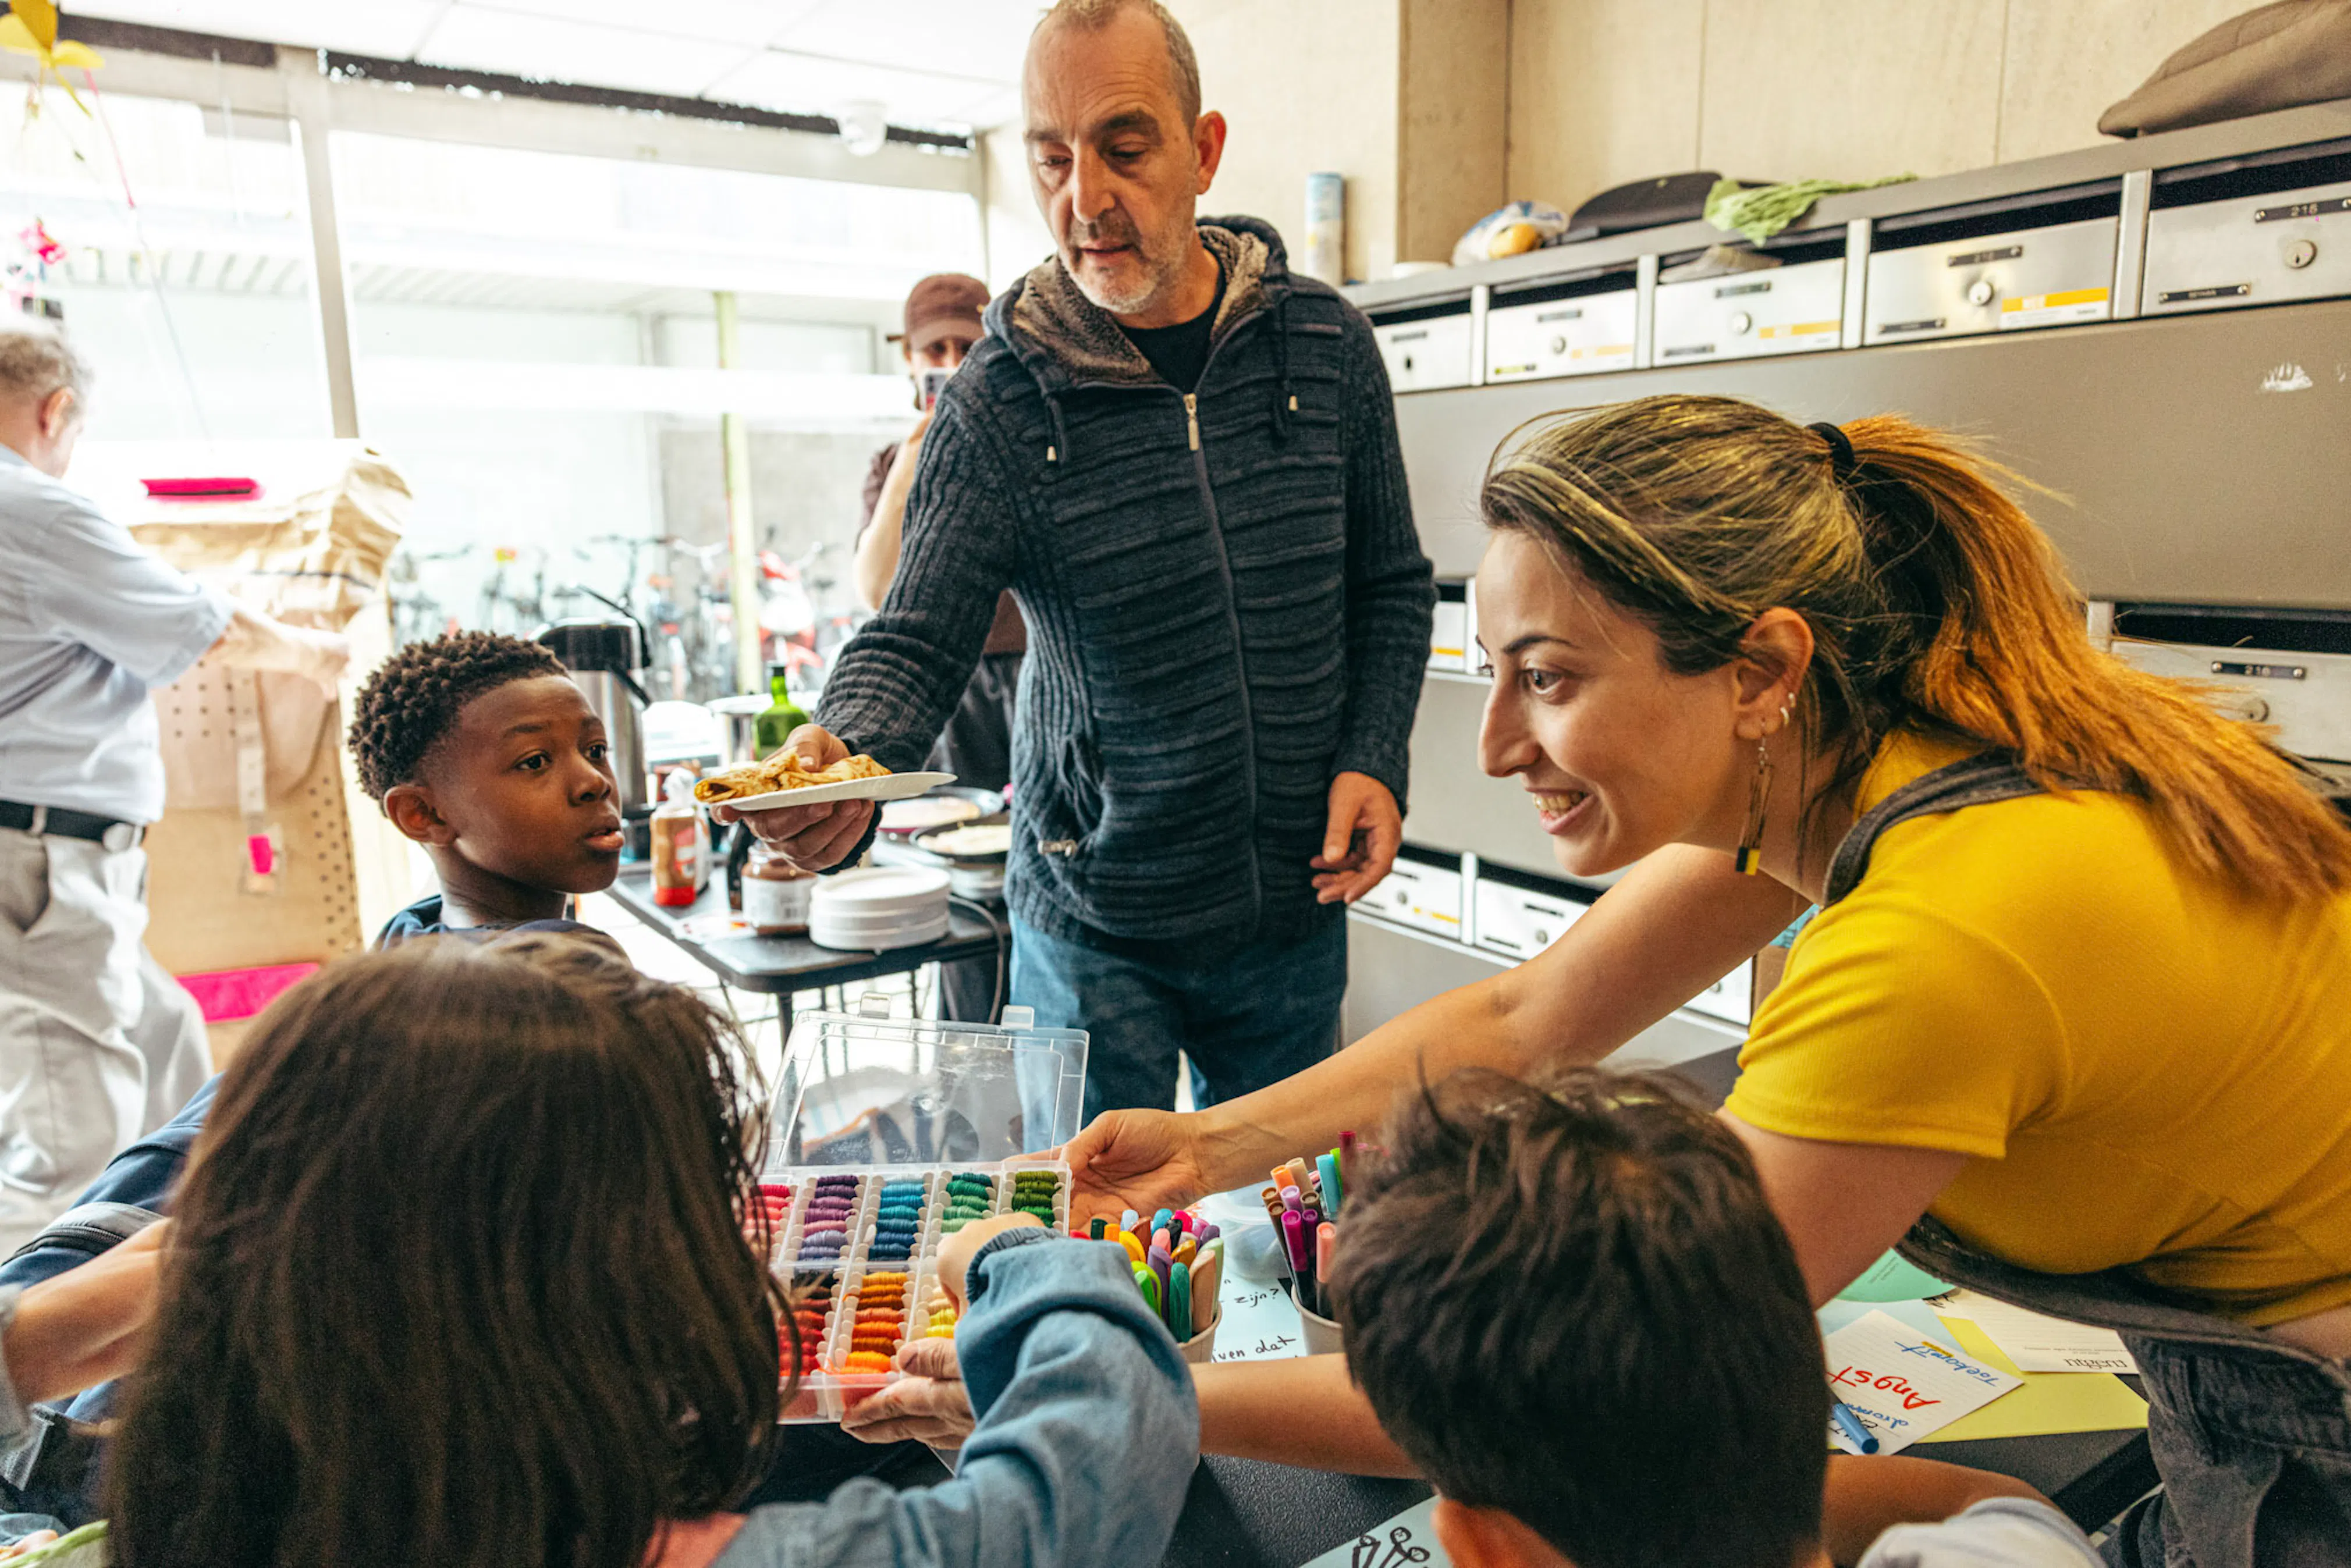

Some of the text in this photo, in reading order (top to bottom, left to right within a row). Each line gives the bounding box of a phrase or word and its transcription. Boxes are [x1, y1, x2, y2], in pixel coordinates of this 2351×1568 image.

[1234, 1288, 1280, 1308] zijn?
[1255, 1335, 1297, 1354] dat
[1826, 1366, 1941, 1410] Angst
